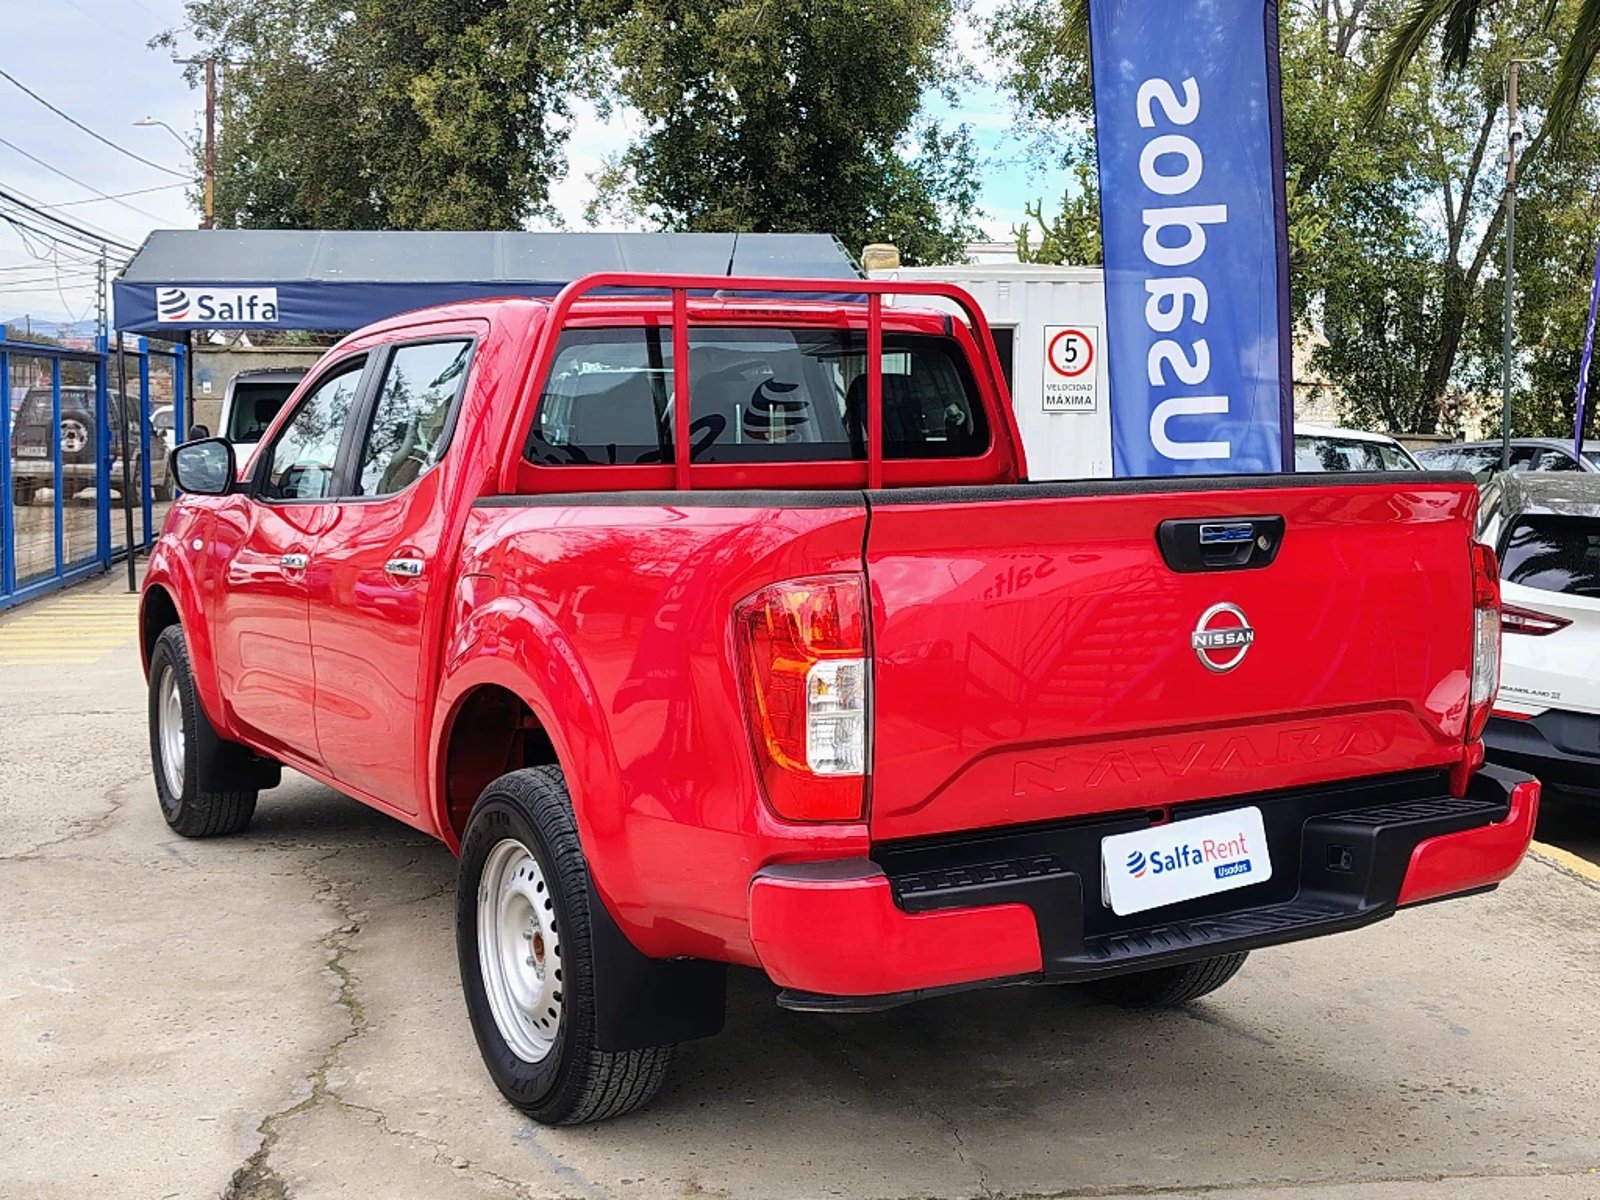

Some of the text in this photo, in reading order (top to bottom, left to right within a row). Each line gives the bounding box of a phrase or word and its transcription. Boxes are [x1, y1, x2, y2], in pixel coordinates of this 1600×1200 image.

[197, 294, 276, 320] Salfa
[1064, 338, 1078, 363] 5
[1046, 383, 1093, 391] VELOCIDAD
[1046, 393, 1093, 405] MÁXIMA
[1194, 630, 1254, 646] NISSAN
[1012, 719, 1388, 797] NAVARA
[1150, 832, 1248, 874] SalfaRent
[1218, 862, 1248, 877] Usados
